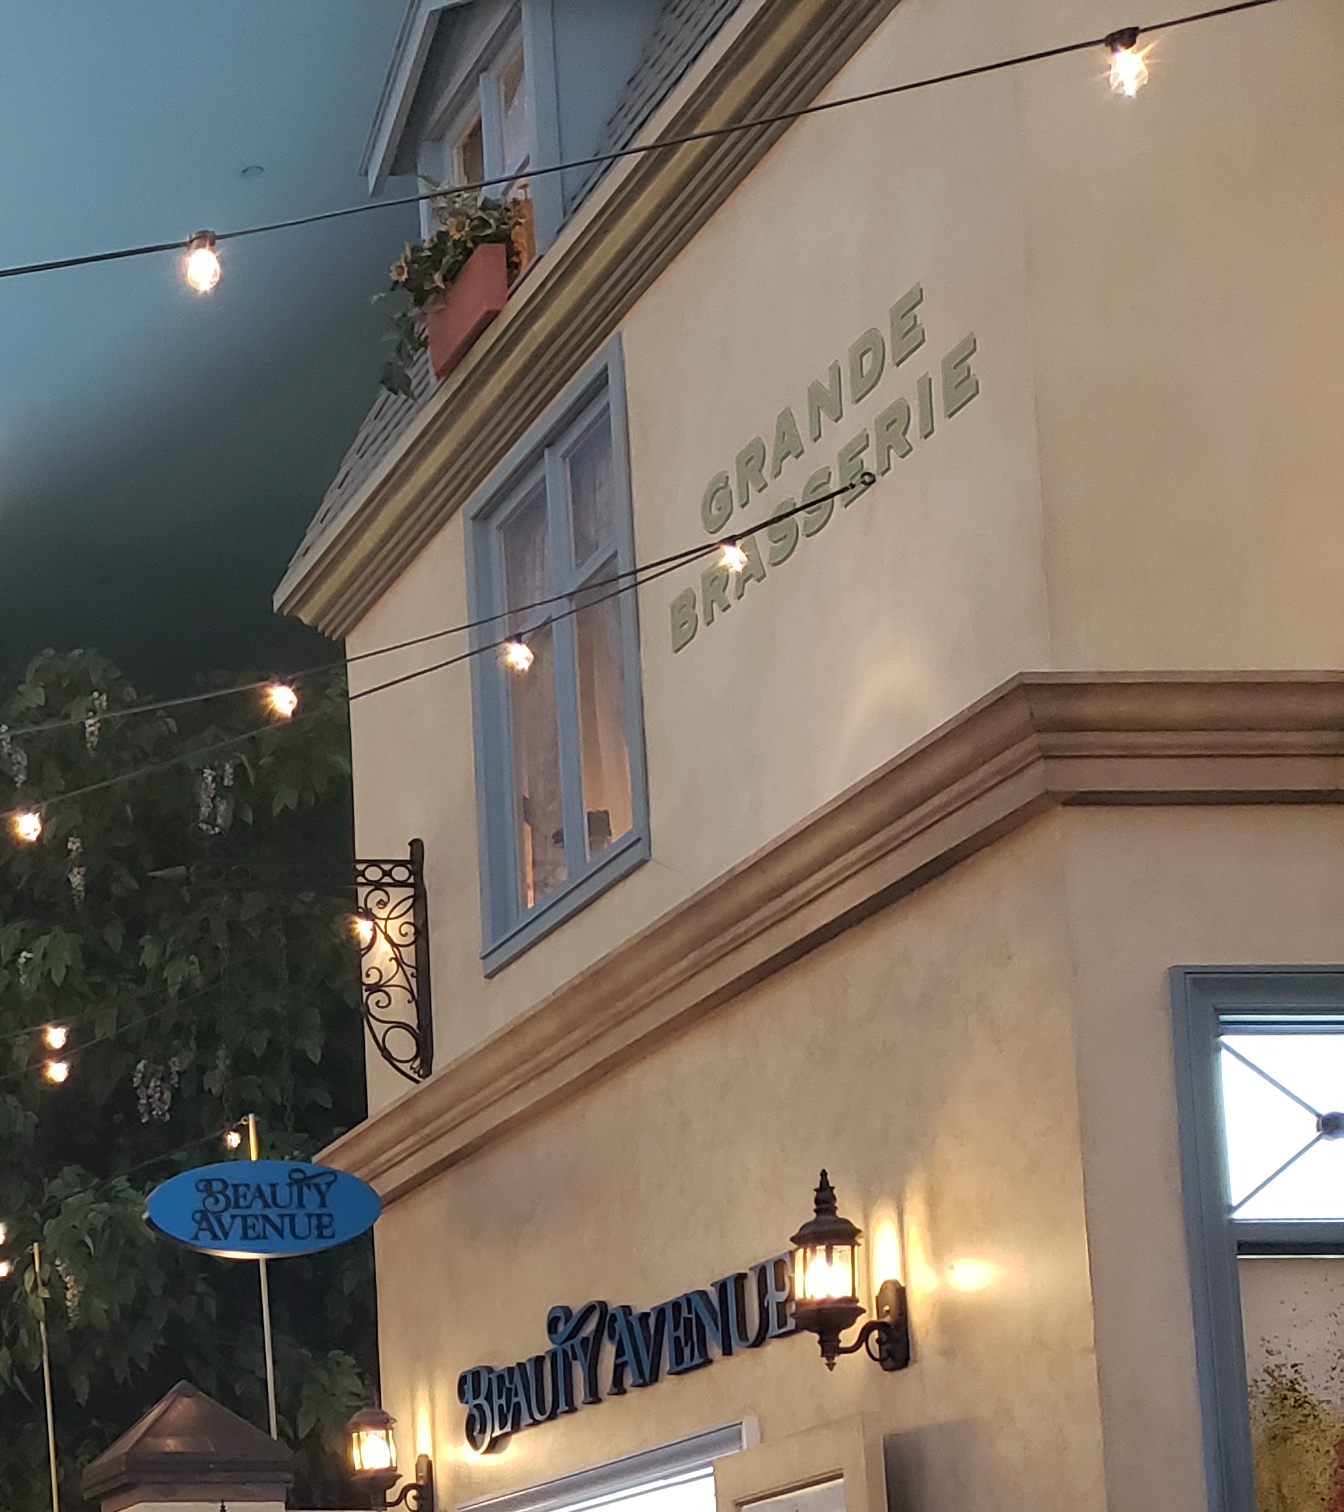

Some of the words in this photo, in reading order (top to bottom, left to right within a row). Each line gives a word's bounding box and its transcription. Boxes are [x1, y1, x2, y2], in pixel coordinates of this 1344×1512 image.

[670, 331, 980, 654] BRASSERIE
[701, 282, 926, 534] GRANDE
[191, 1210, 336, 1241] AVENUE
[195, 1168, 337, 1213] BEAUTY
[457, 1300, 609, 1454] BEAUTY
[607, 1250, 797, 1396] AVENUE
